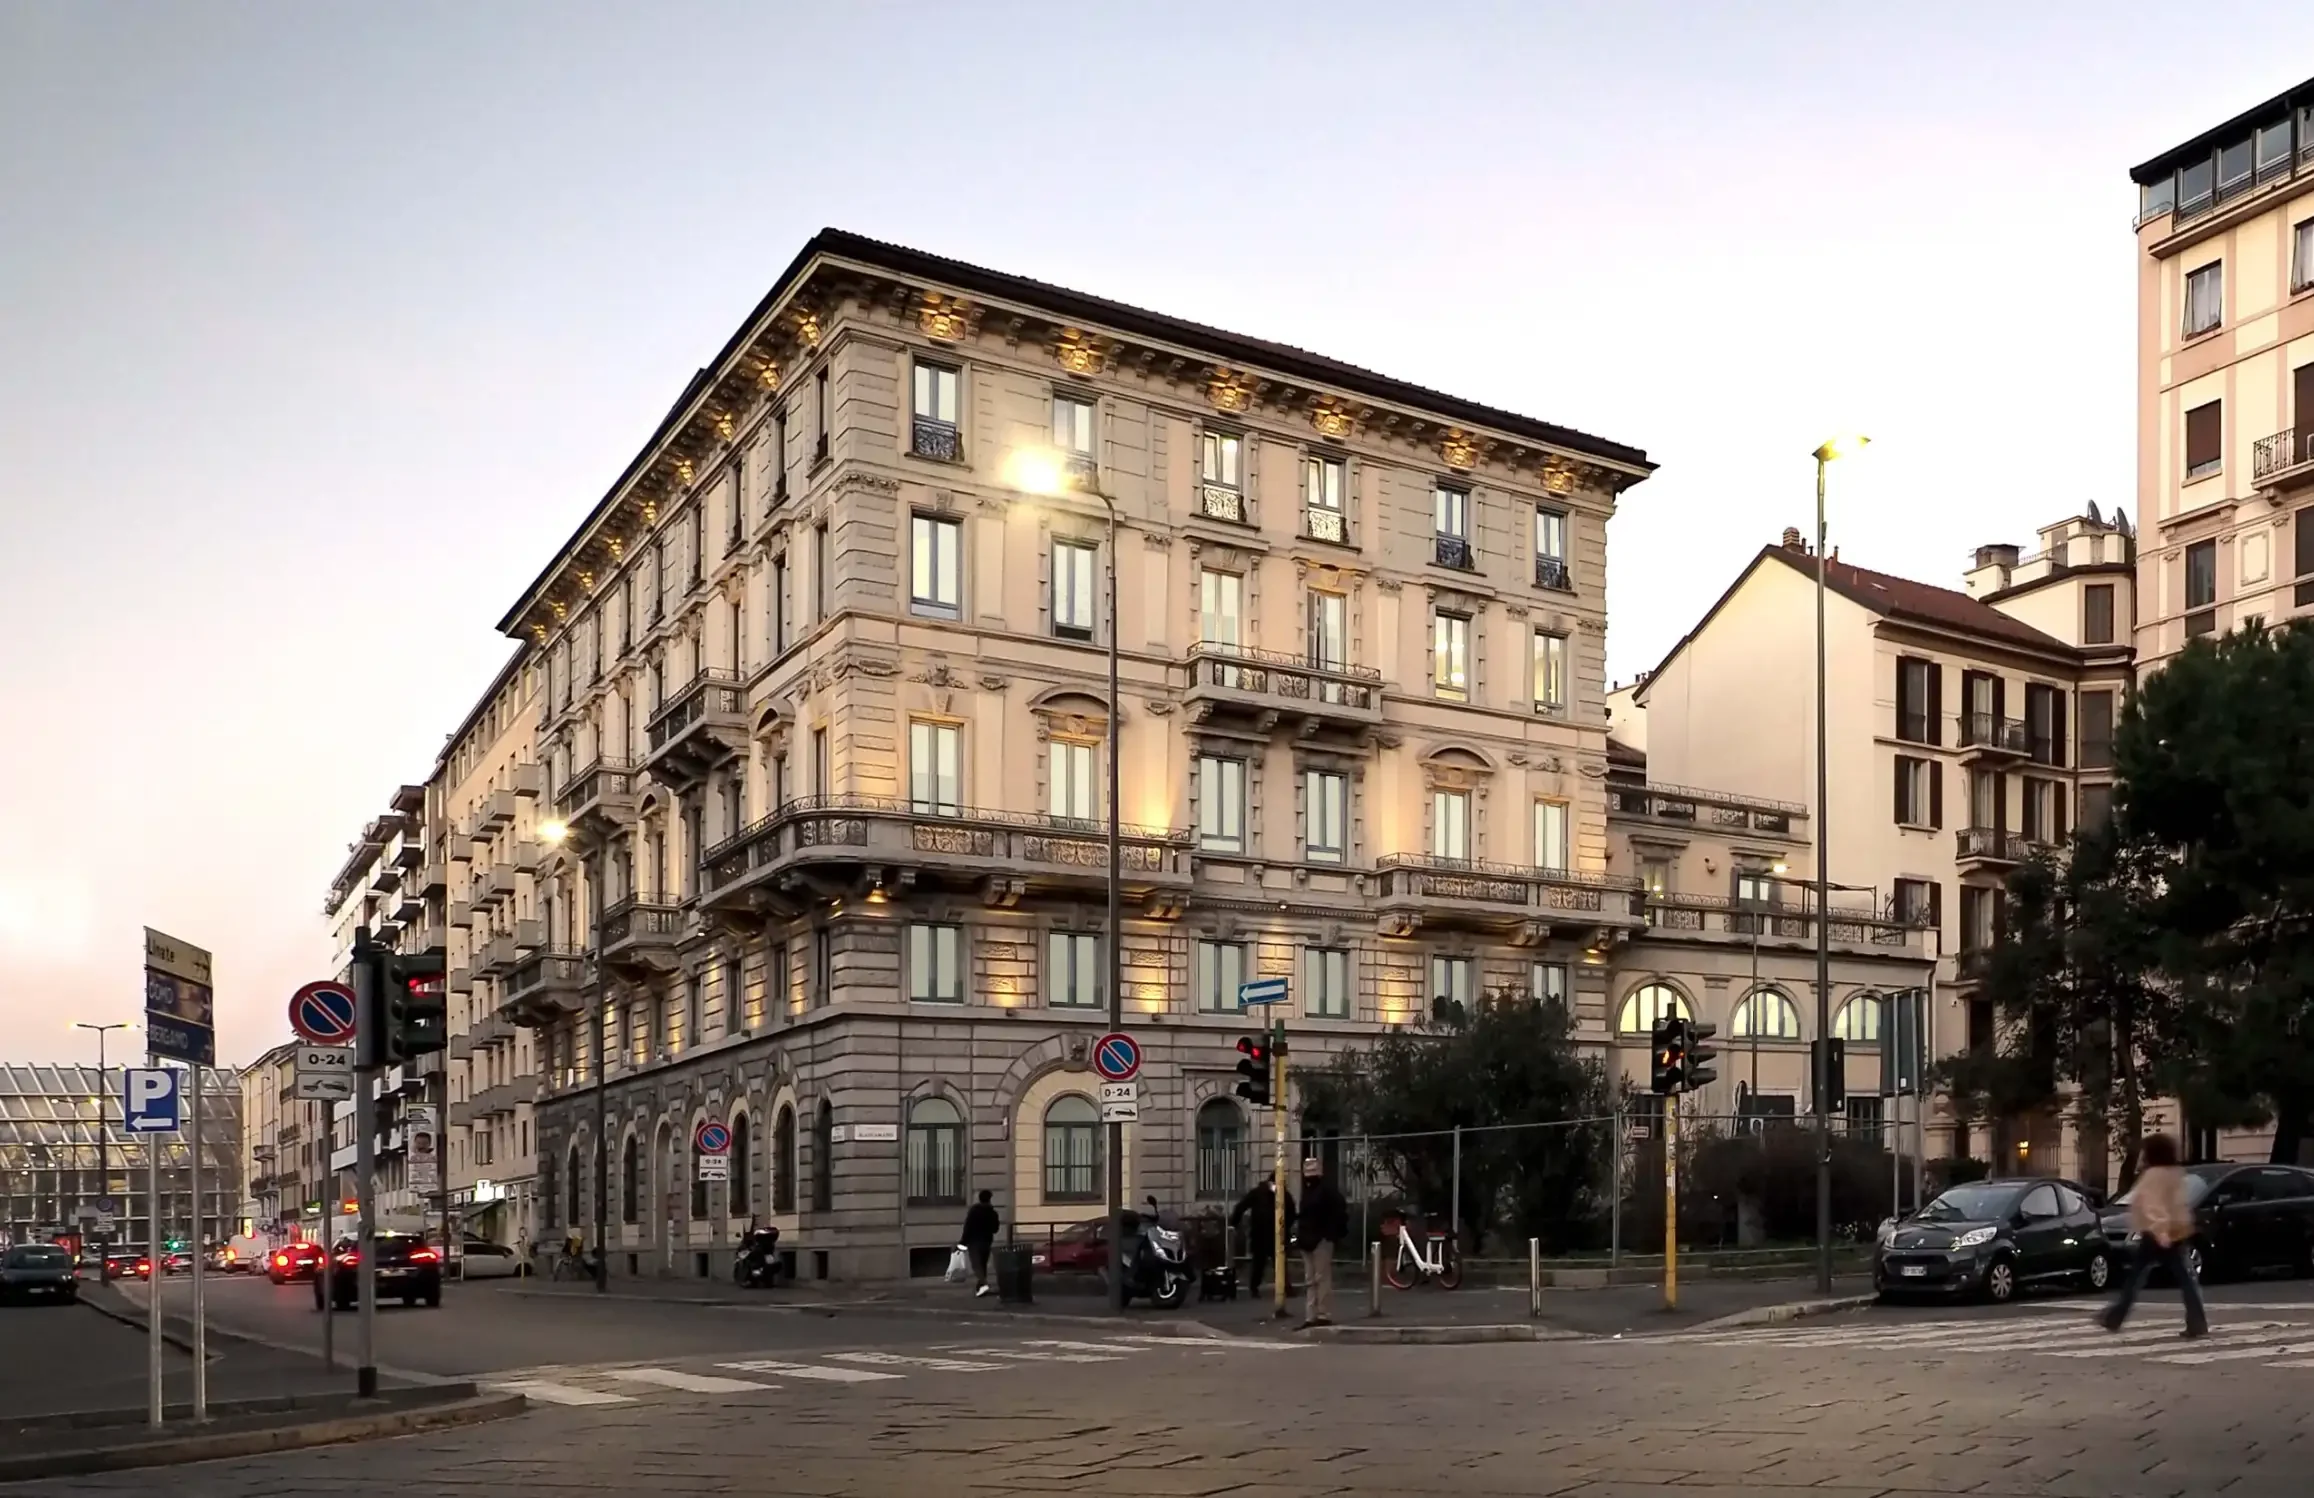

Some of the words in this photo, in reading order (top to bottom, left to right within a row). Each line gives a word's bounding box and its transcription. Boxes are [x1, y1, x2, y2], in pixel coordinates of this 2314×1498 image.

[308, 1053, 345, 1066] 0-24
[130, 1070, 172, 1112] P
[1104, 1087, 1131, 1097] 0-24
